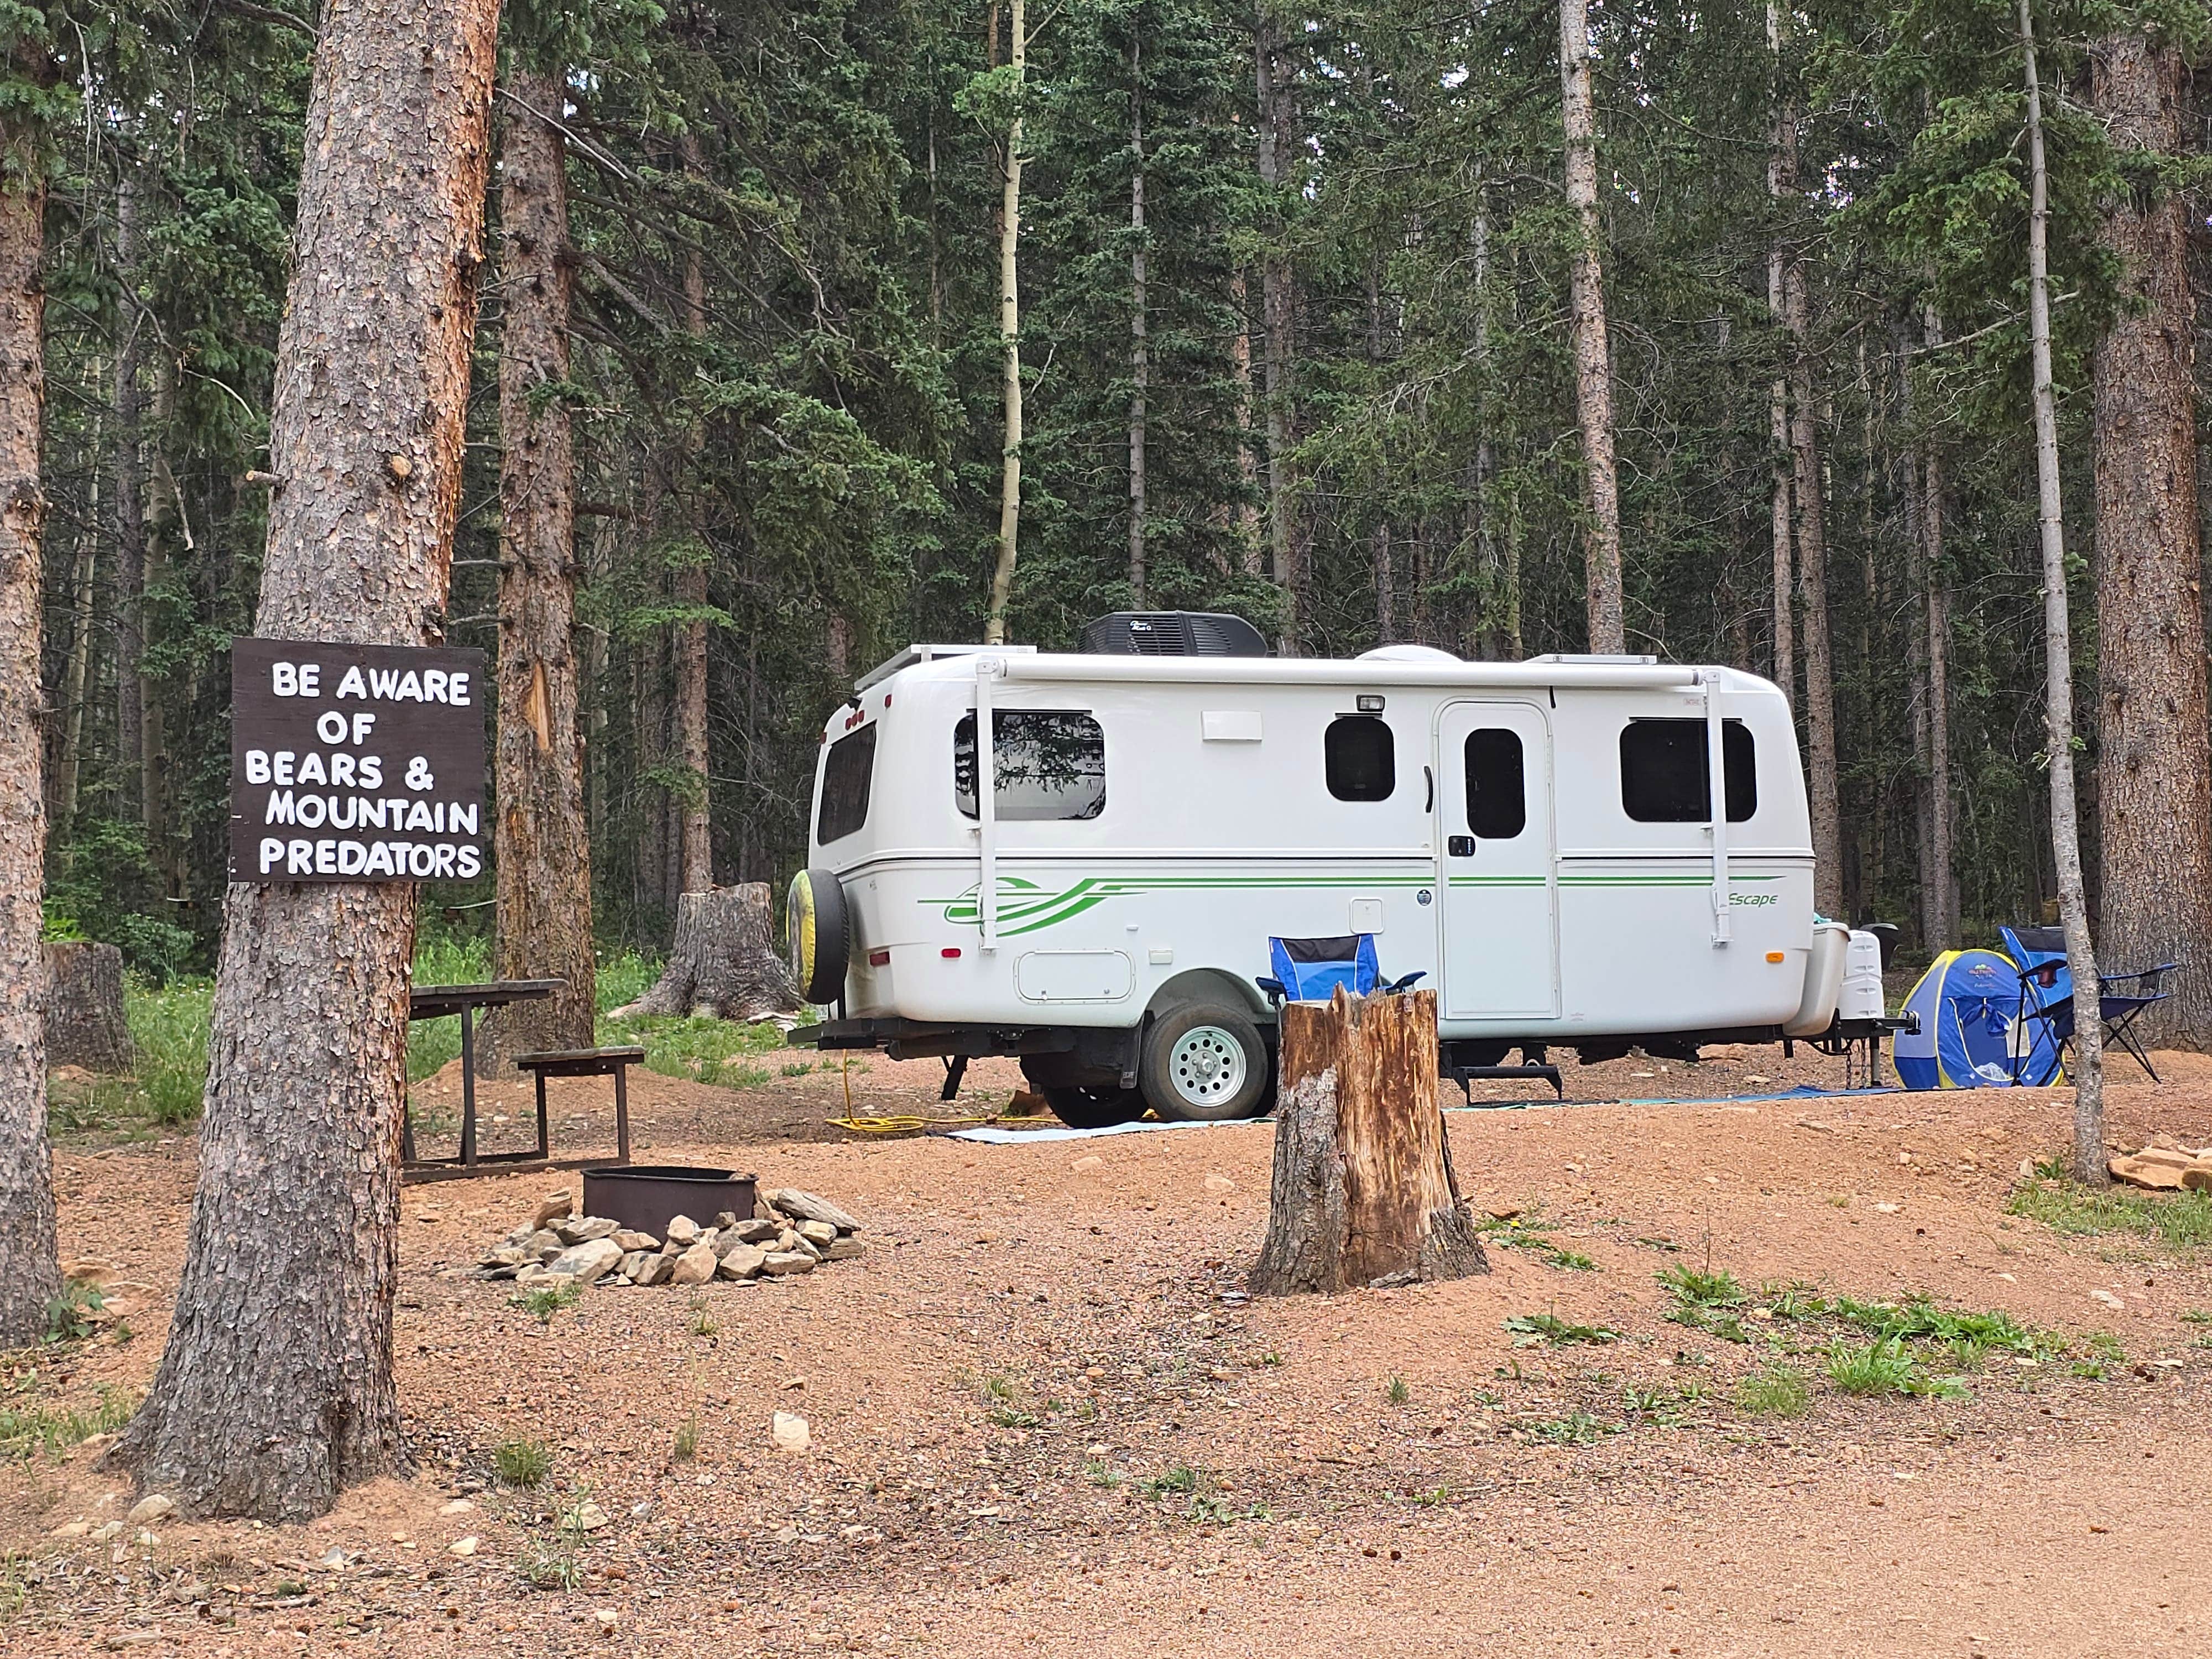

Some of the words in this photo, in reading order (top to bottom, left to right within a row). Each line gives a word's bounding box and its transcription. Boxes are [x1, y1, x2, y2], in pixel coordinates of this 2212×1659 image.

[272, 661, 320, 697] BE
[336, 665, 471, 706] AWARE
[316, 711, 376, 745] OF
[246, 749, 383, 789] BEARS
[405, 756, 434, 791] &
[265, 789, 478, 836] MOUNTAIN
[259, 837, 481, 879] PREDATORS
[1729, 893, 1778, 907] Escape
